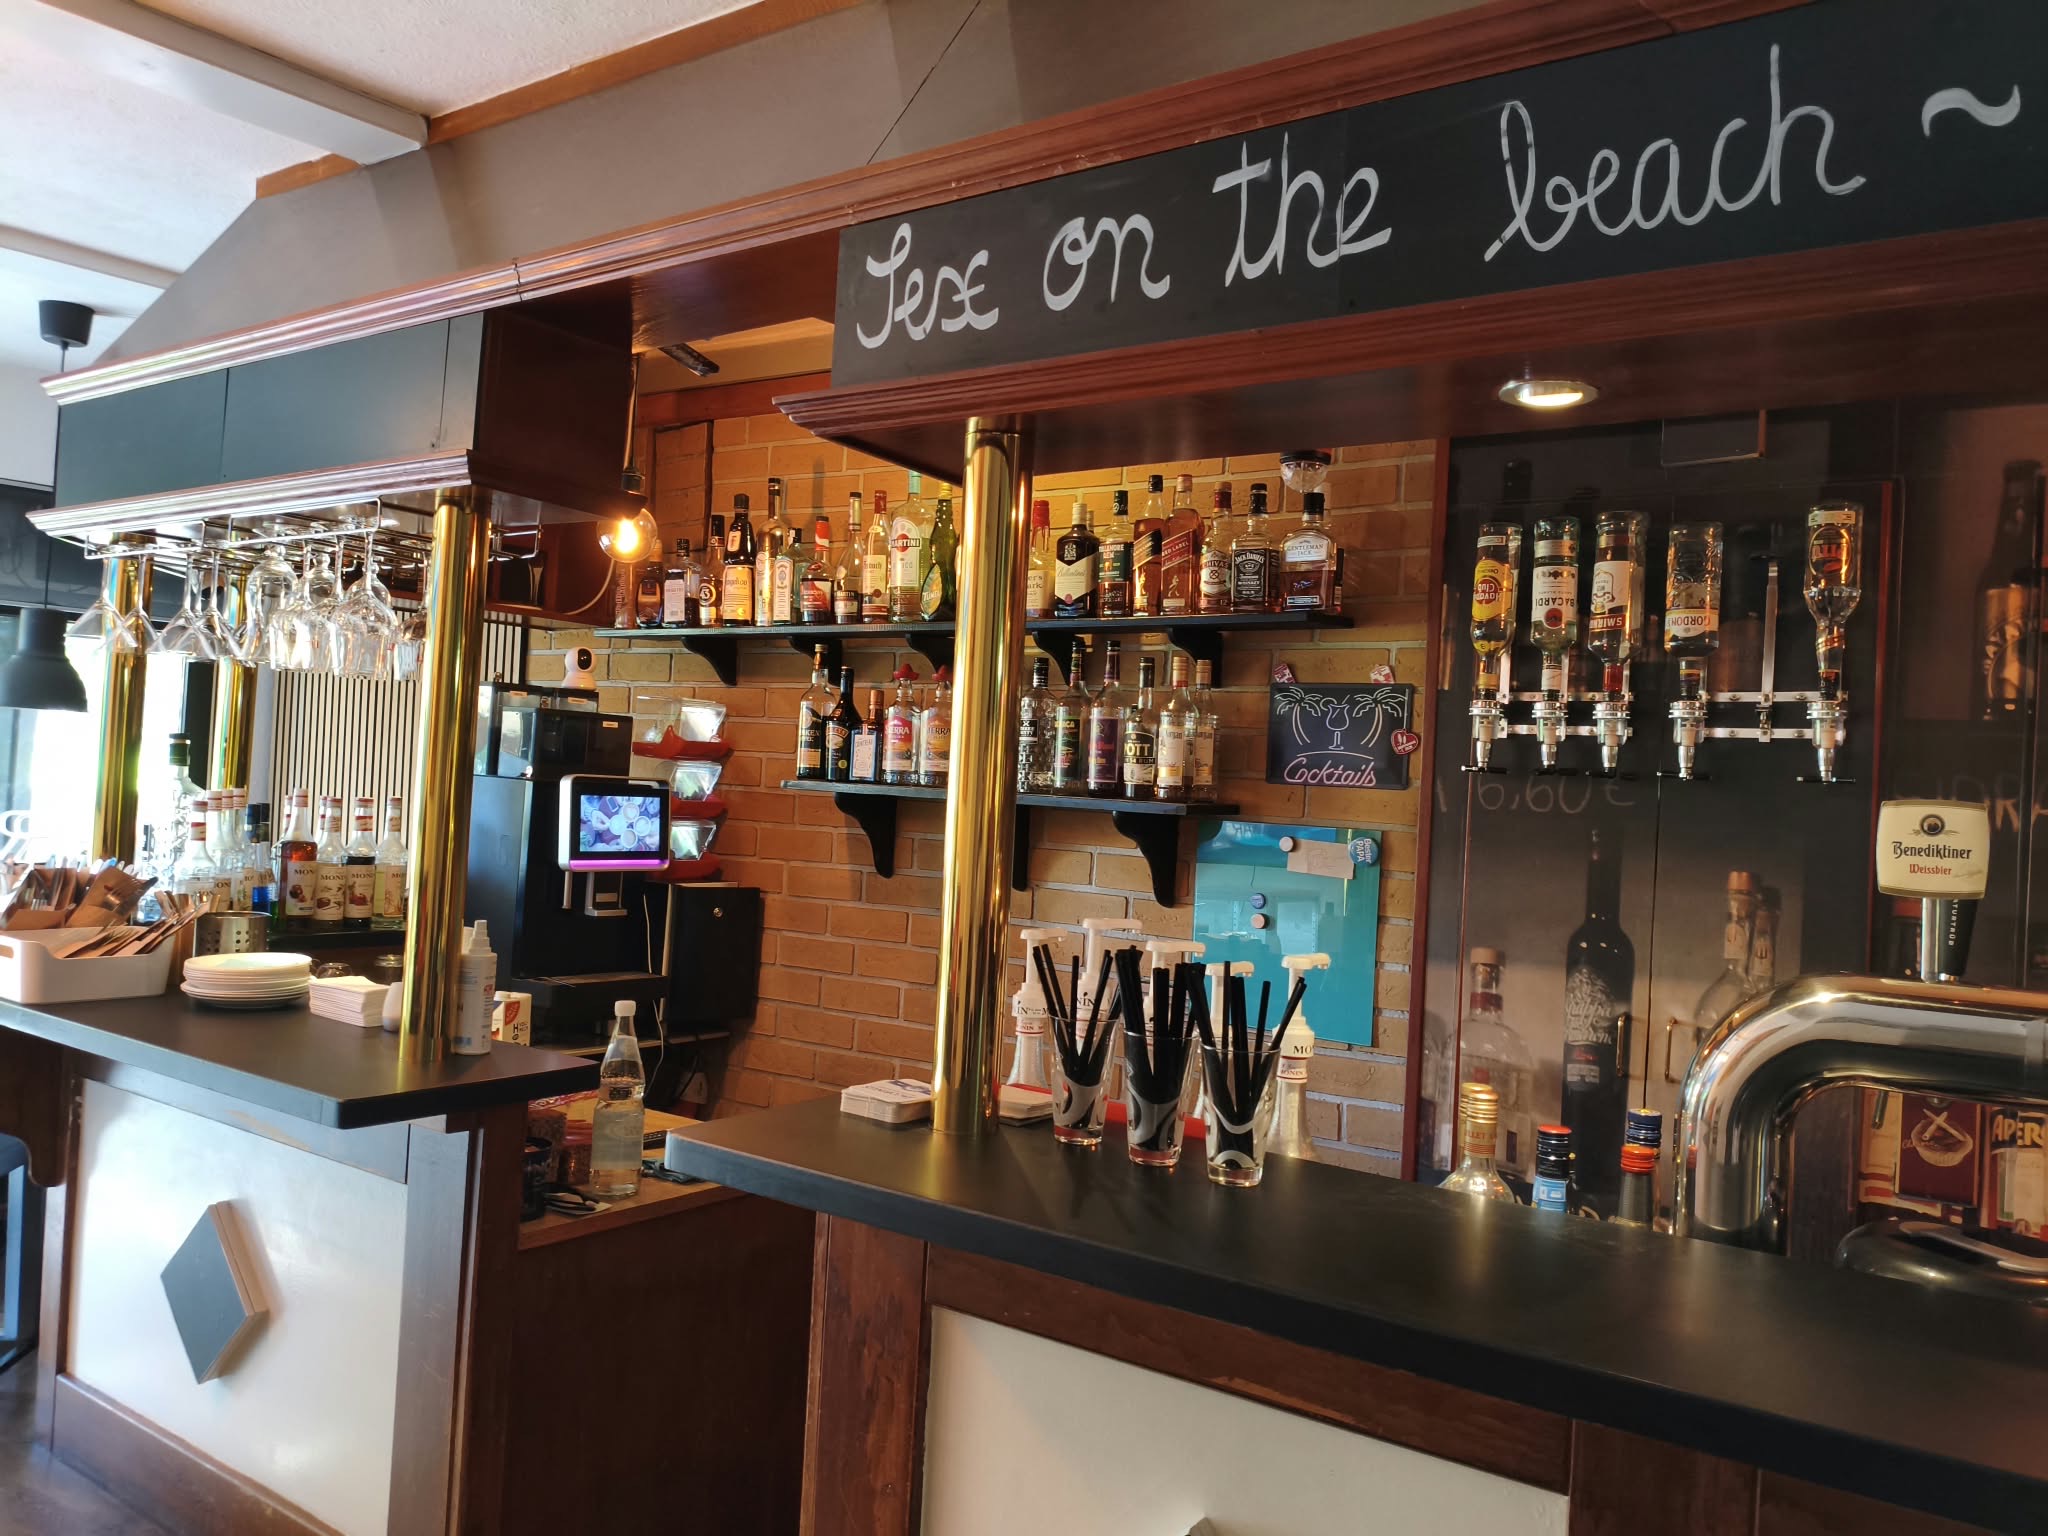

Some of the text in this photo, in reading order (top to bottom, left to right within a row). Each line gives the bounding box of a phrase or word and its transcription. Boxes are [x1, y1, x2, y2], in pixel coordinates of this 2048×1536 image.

[856, 43, 1866, 349] Sex on the beach
[1172, 541, 1189, 553] LABEL
[1286, 543, 1324, 552] GENTLEMAN
[1234, 554, 1247, 564] JACK
[1477, 583, 1495, 591] Club
[1535, 597, 1575, 607] BACARDI
[885, 726, 910, 735] SIERRA
[1284, 757, 1377, 786] Cocktails
[1356, 840, 1364, 862] PAPA
[1891, 841, 1973, 860] Benediktiner
[1909, 863, 1952, 876] Weissbier
